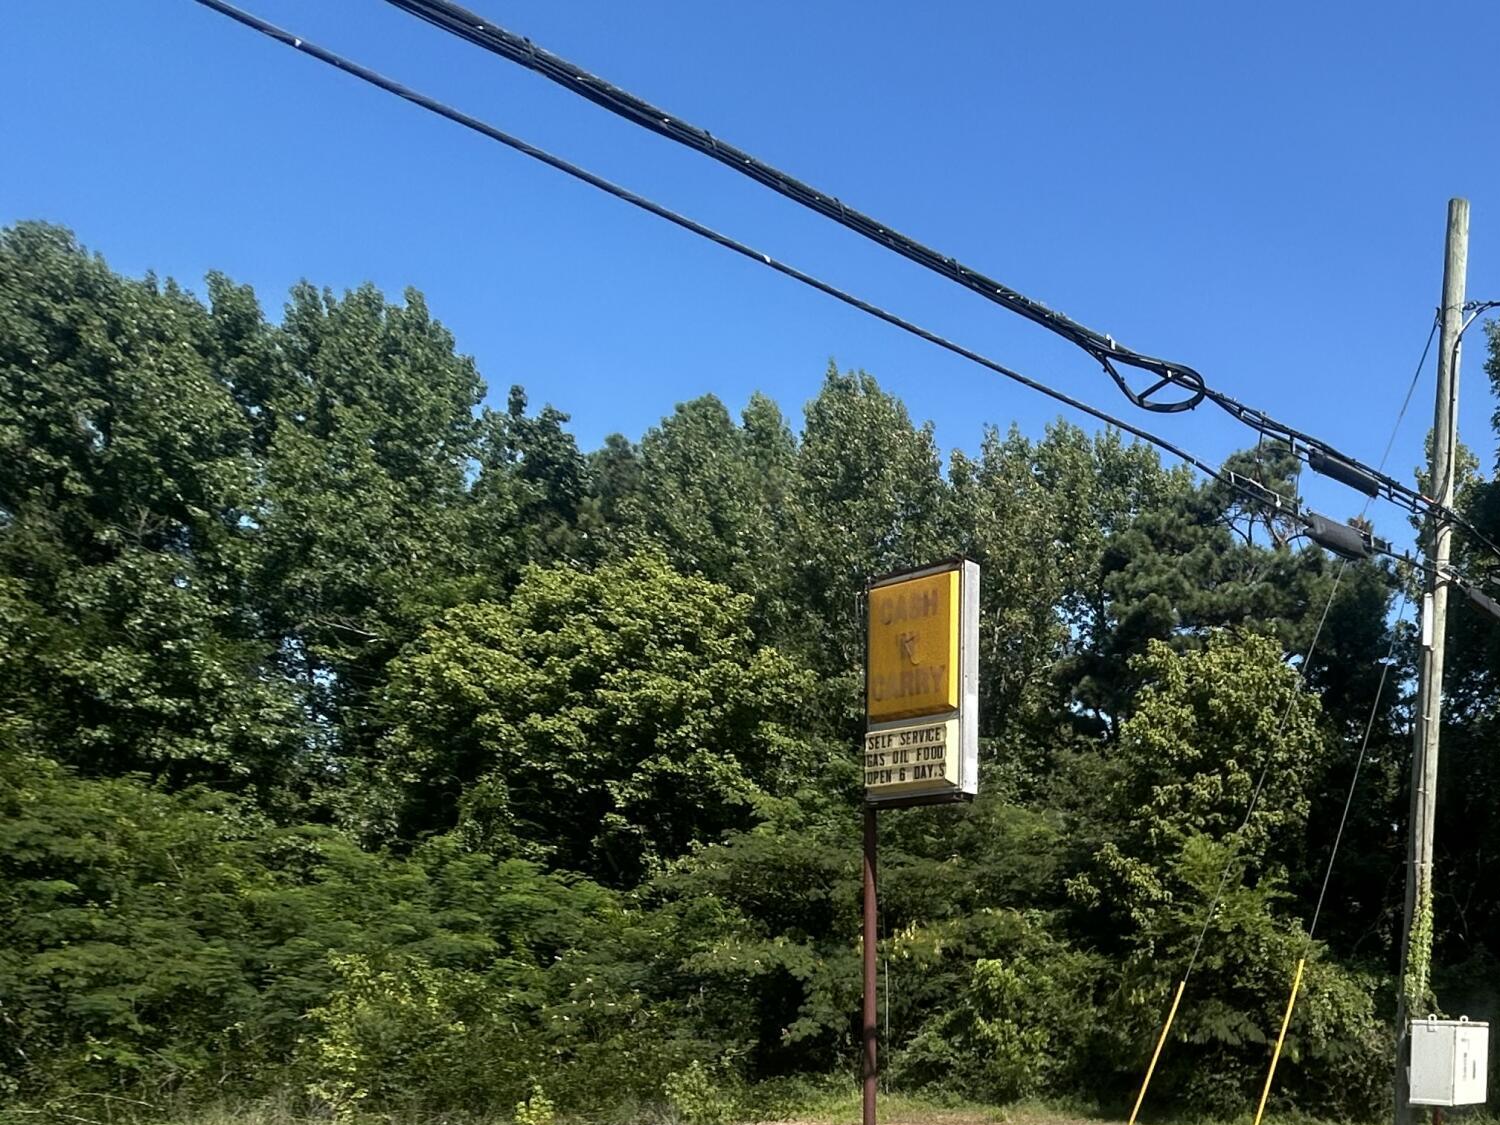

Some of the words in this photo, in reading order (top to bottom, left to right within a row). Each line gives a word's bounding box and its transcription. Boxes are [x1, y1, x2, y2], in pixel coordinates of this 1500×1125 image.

[880, 588, 939, 625] CASH
[871, 664, 946, 701] CARRY
[868, 734, 892, 750] SELF
[900, 727, 941, 745] SERVICE
[866, 753, 885, 767] GAS
[892, 749, 908, 764] OIL
[916, 745, 943, 761] FOOD
[866, 769, 892, 785] OPEN
[899, 767, 906, 781] 6
